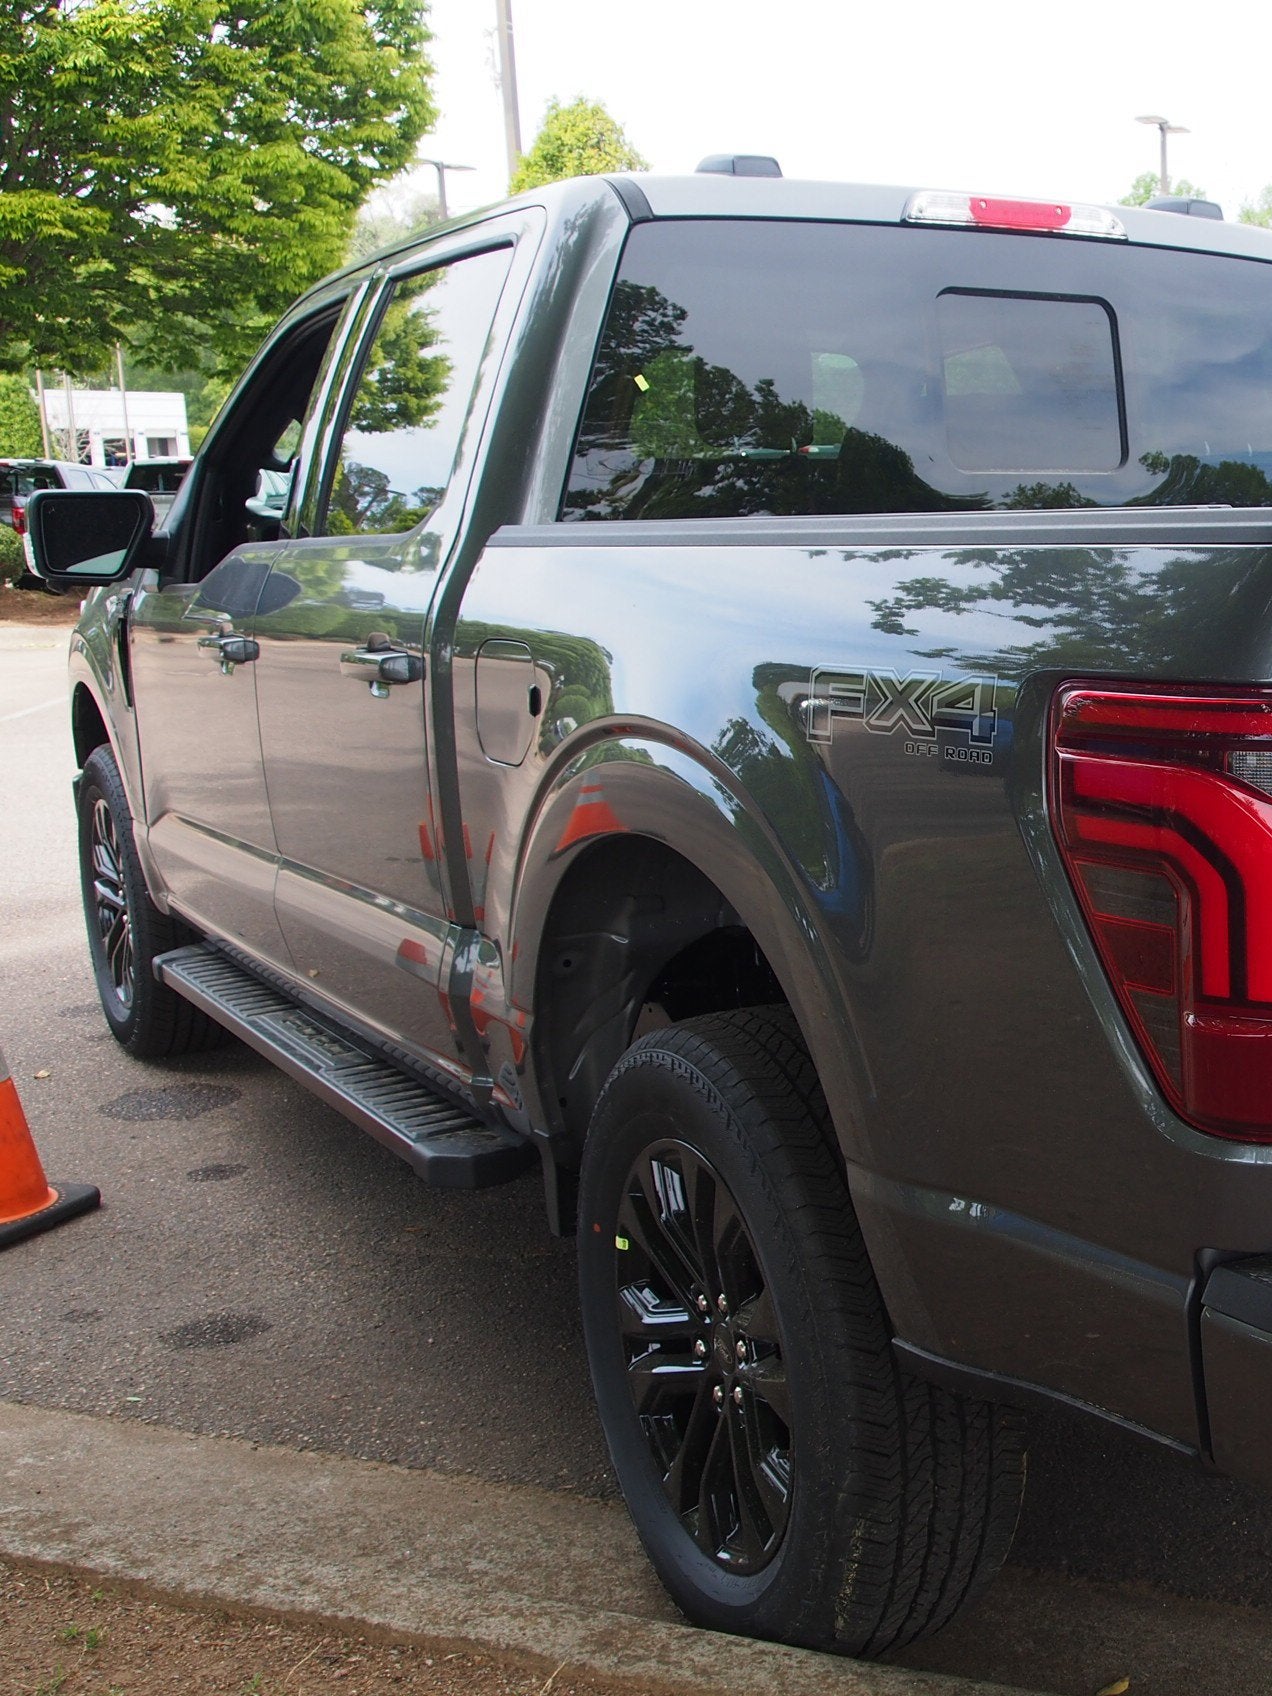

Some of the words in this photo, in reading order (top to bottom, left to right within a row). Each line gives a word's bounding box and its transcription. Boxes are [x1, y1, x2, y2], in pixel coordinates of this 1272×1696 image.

[806, 663, 998, 747] FX4
[904, 741, 939, 757] OFF
[944, 747, 993, 765] ROAD
